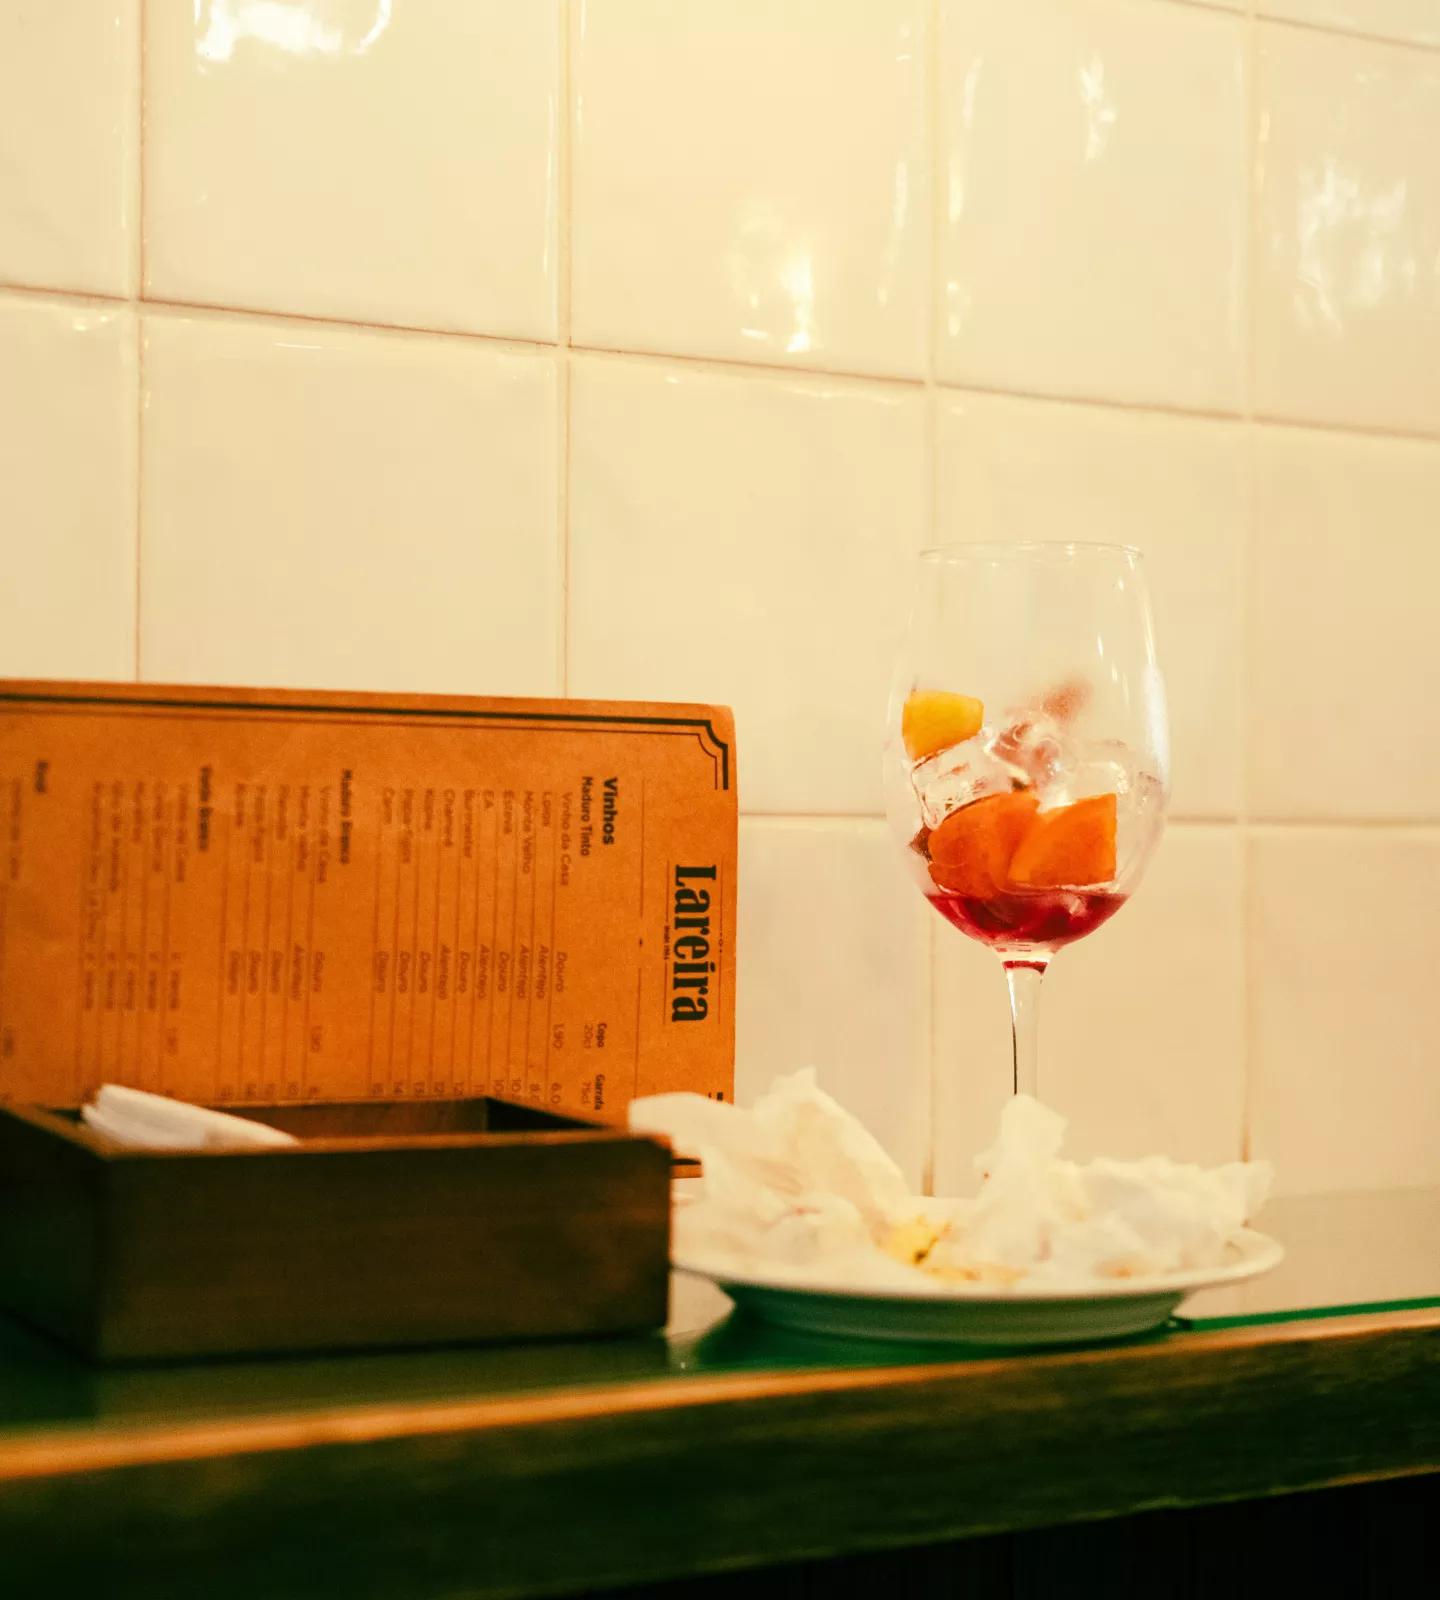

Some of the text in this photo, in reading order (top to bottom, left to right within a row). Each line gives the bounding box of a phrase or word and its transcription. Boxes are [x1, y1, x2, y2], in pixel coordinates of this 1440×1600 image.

[340, 768, 354, 866] Maduro Branco
[484, 790, 495, 810] EA
[523, 790, 534, 833] Monte
[561, 791, 572, 830] Vinho
[580, 776, 594, 857] Maduro Tinto
[602, 777, 619, 845] Vinhos
[522, 835, 534, 874] Velho
[561, 834, 571, 850] da
[560, 854, 571, 886] Casa
[672, 864, 717, 1022] Lareira
[398, 951, 411, 994] Douro
[419, 951, 431, 994] Douro
[438, 944, 452, 1000] Alentejo
[457, 951, 471, 994] Douro
[477, 943, 490, 1000] Alentejo
[498, 951, 510, 993] Douro
[516, 944, 530, 1000] Alentejo
[536, 944, 549, 999] Alentejo
[556, 952, 568, 992] Douro
[594, 1022, 607, 1110] Copo Garrafa
